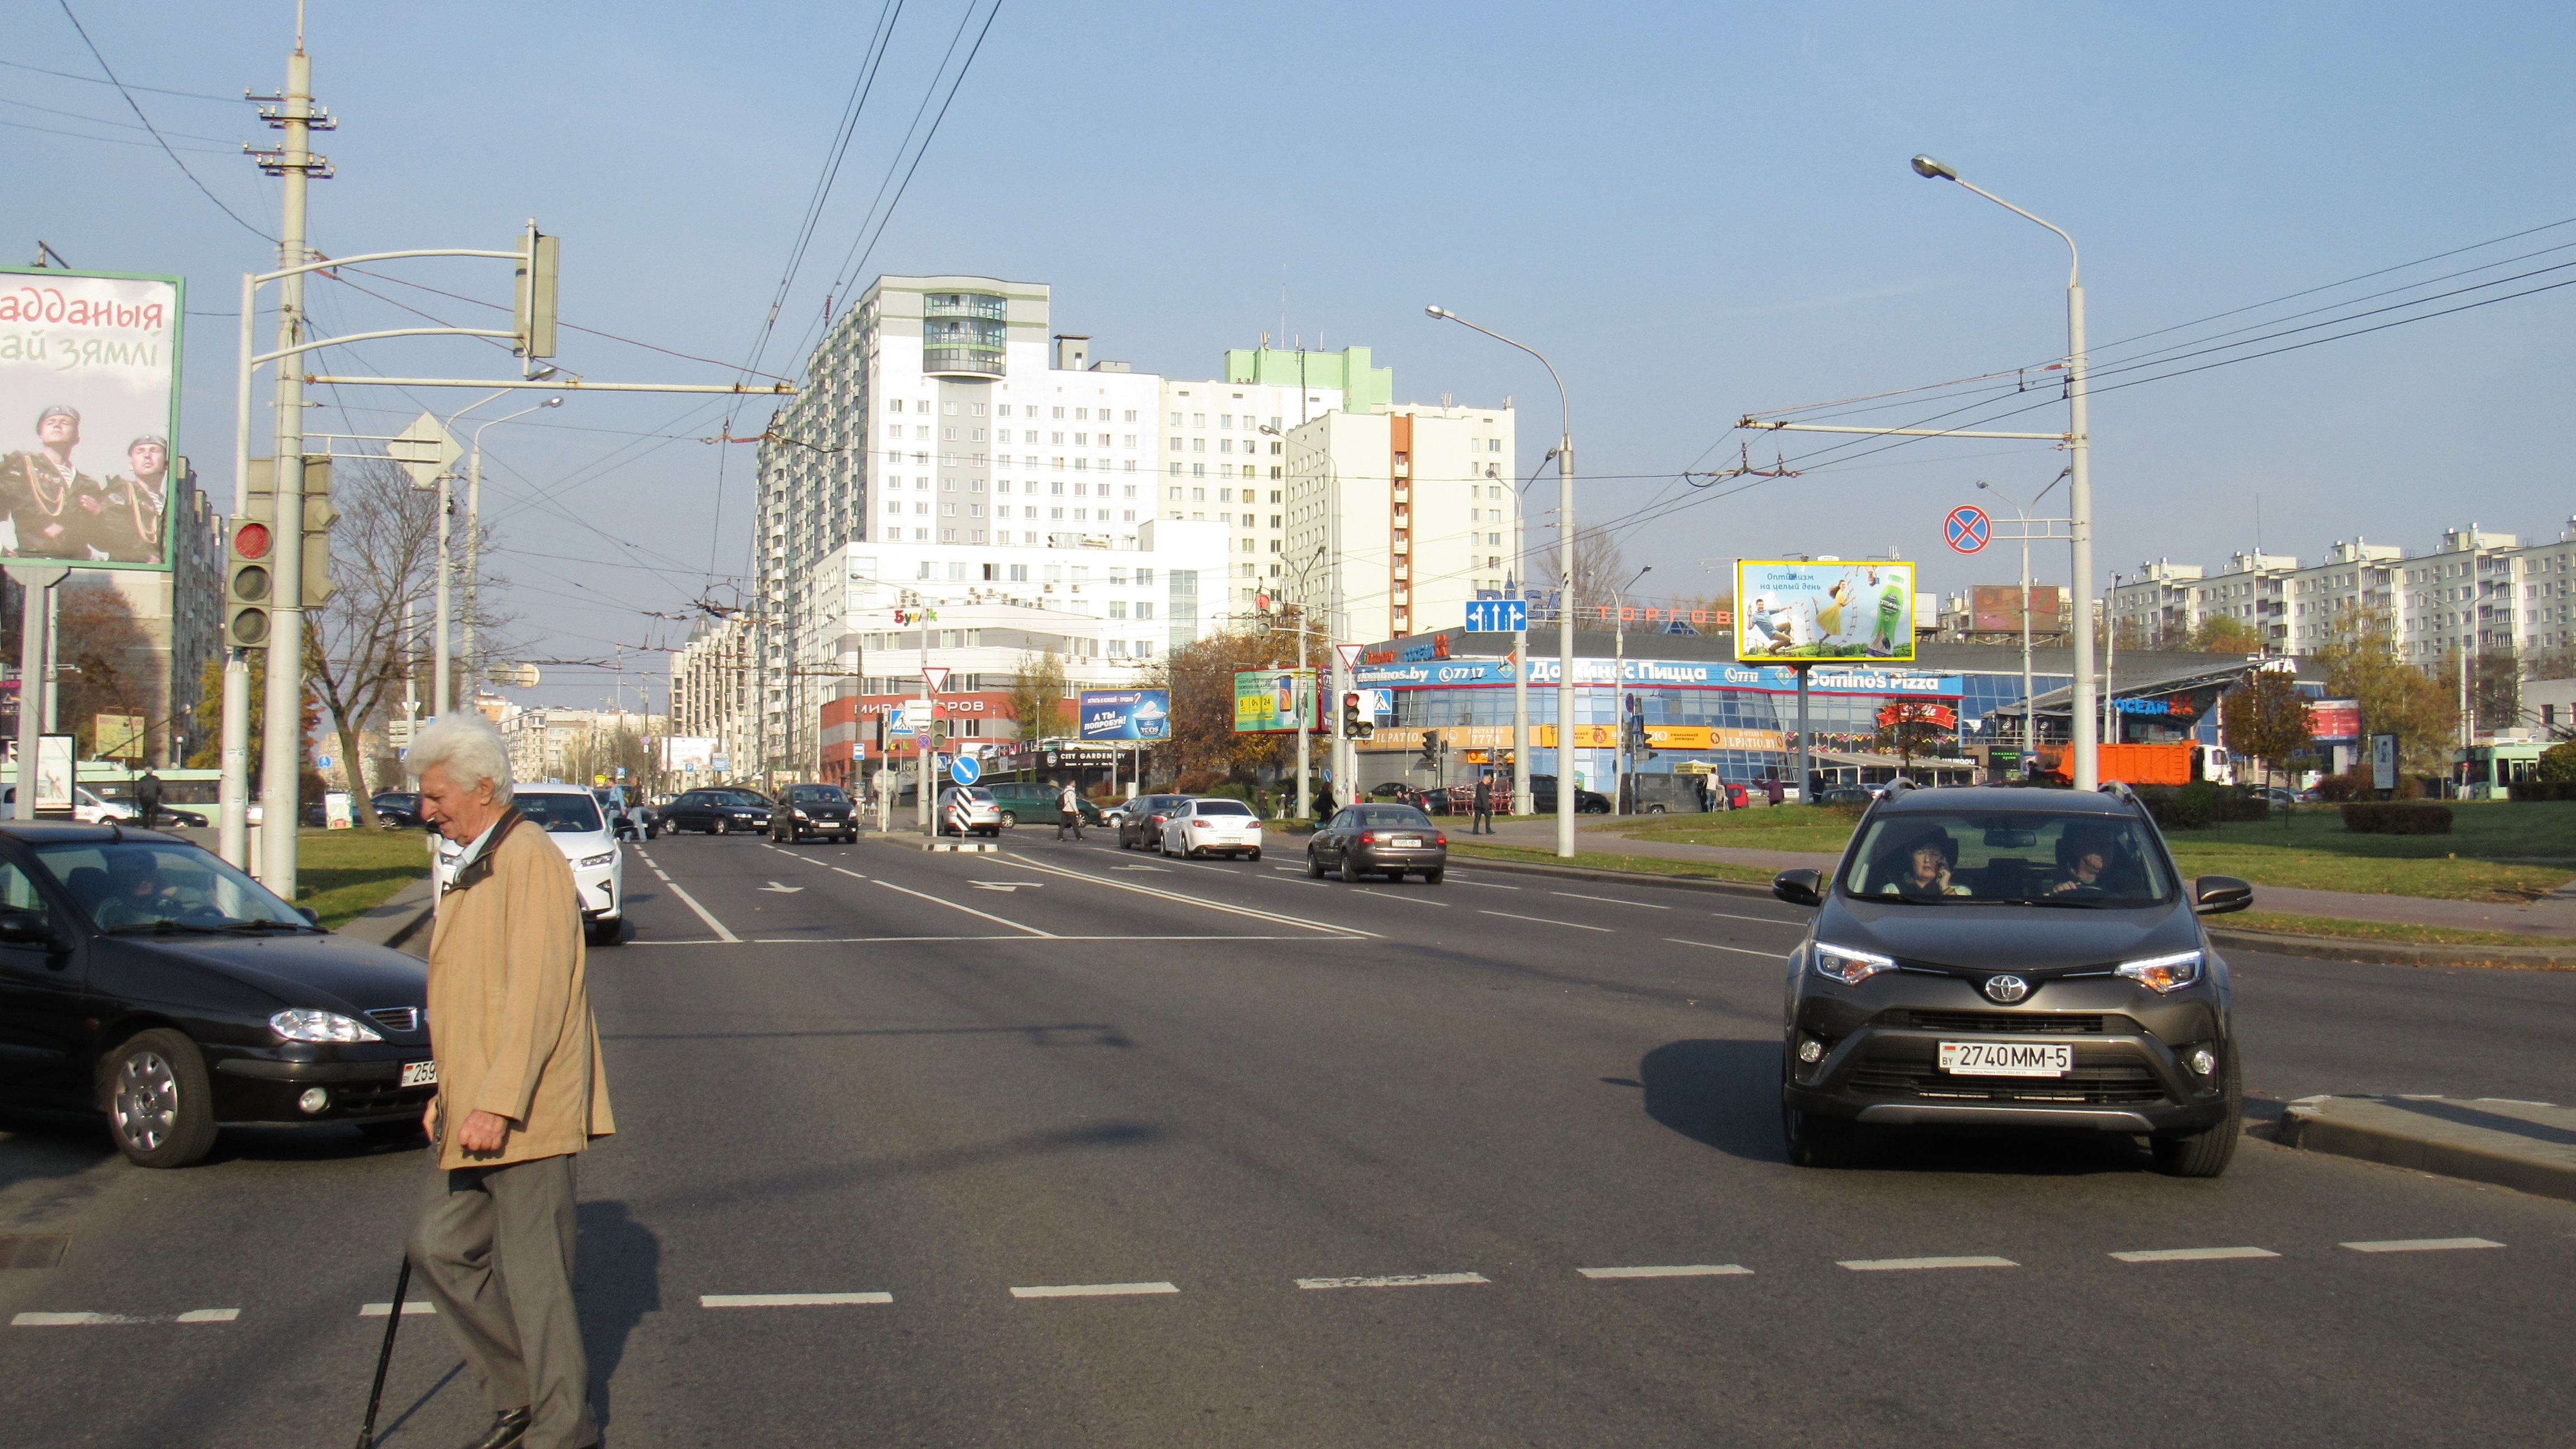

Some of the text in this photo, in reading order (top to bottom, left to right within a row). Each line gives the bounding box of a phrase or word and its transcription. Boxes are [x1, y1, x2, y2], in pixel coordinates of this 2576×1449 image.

[0, 287, 163, 331] адданыя
[56, 330, 162, 371] зямлі
[1357, 666, 1429, 683] dominos.by
[1638, 662, 1707, 683] Пицца
[1807, 670, 1939, 690] Domino's Pizza
[2104, 699, 2168, 715] ОСЕДИ
[1084, 716, 1127, 731] ПОПРОБУЙ!
[1093, 711, 1116, 722] А ТЫ
[1942, 1057, 1954, 1066] BY
[413, 1062, 438, 1083] 259
